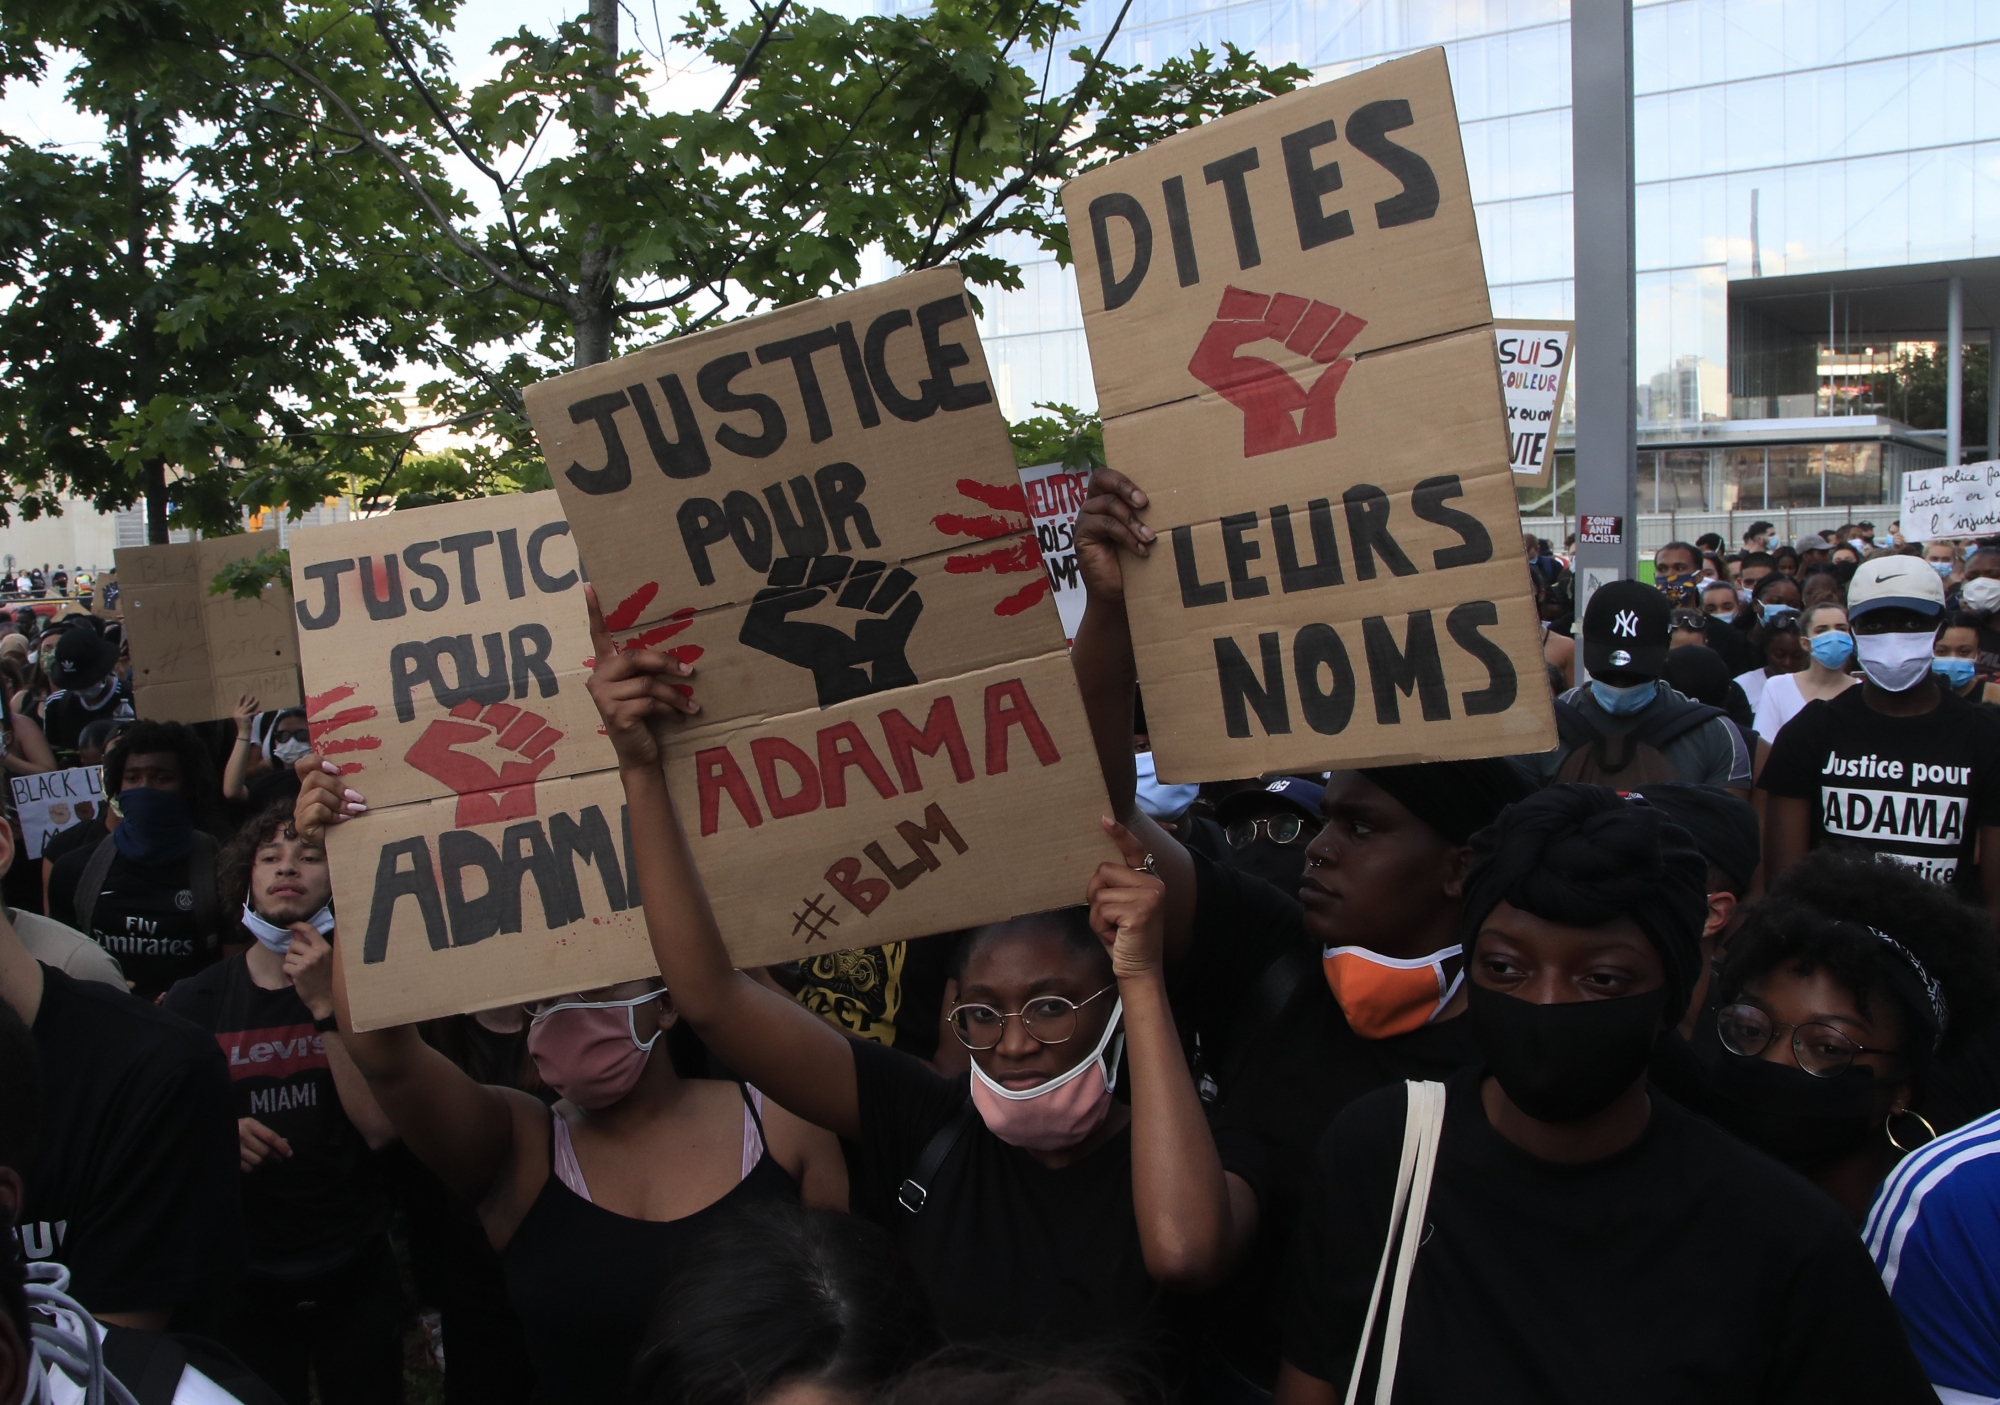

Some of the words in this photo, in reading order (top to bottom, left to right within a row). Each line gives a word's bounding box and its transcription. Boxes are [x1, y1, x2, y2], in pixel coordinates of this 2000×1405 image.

[1088, 98, 1440, 312] DITES
[564, 293, 993, 495] JUSTICE
[1908, 474, 1931, 492] La
[1942, 469, 1980, 490] police
[676, 461, 882, 586] POUR
[1171, 474, 1493, 608] LEURS
[1581, 535, 1620, 543] RACISTE
[1587, 516, 1614, 526] ZONE
[1589, 526, 1611, 534] ANTI
[296, 520, 589, 631] JUSTIC
[1612, 609, 1639, 637] NY
[389, 623, 559, 723] POUR
[1213, 600, 1517, 738] NOMS
[695, 678, 1061, 838] ADAMA
[1822, 751, 1903, 779] Justice
[1911, 762, 1971, 787] pour
[13, 772, 77, 804] BLACK
[1825, 791, 1961, 840] ADAMA
[792, 802, 969, 944] #BLM
[126, 916, 158, 935] Fly
[250, 1082, 317, 1114] MIAMI
